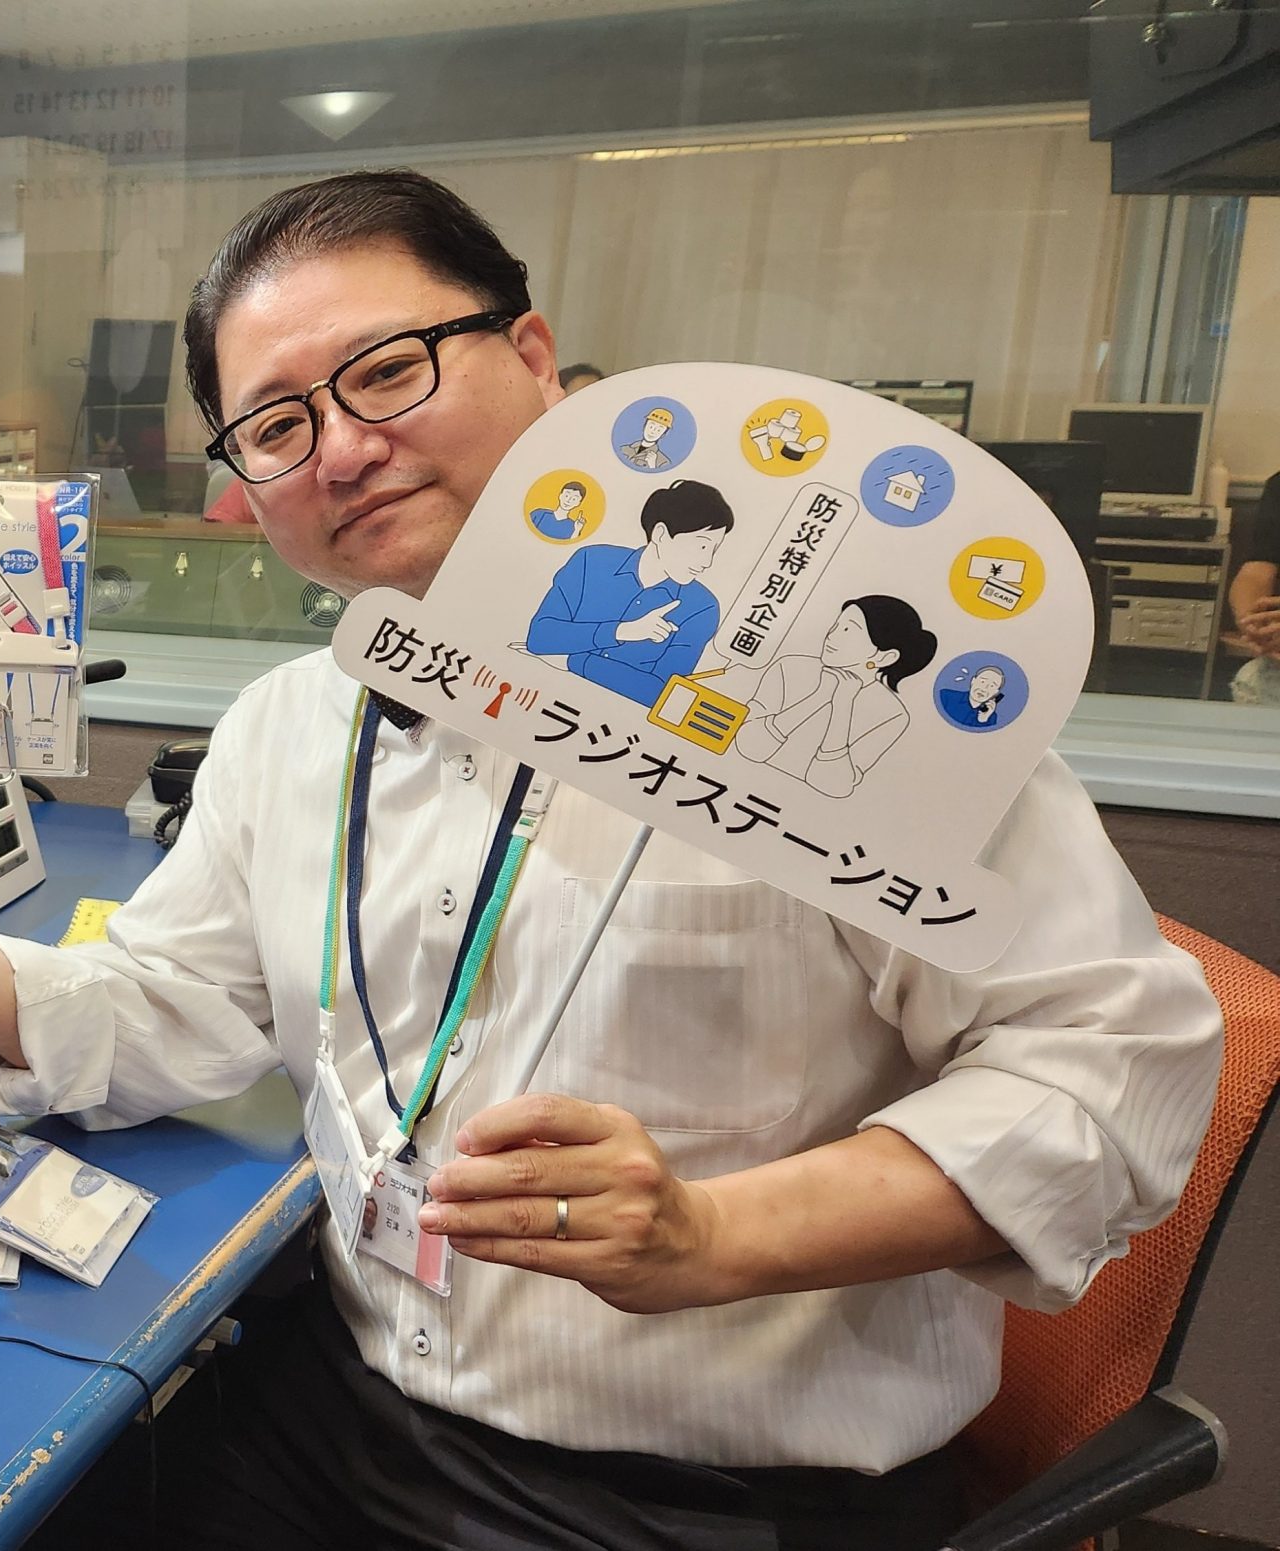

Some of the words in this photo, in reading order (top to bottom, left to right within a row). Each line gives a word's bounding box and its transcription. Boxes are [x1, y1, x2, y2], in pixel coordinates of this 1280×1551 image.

[12, 520, 37, 533] style
[60, 515, 89, 554] 2
[729, 492, 844, 659] 防災特別企画
[993, 592, 1014, 604] CARD
[363, 617, 473, 699] 防災
[534, 700, 979, 932] ラジオステーション
